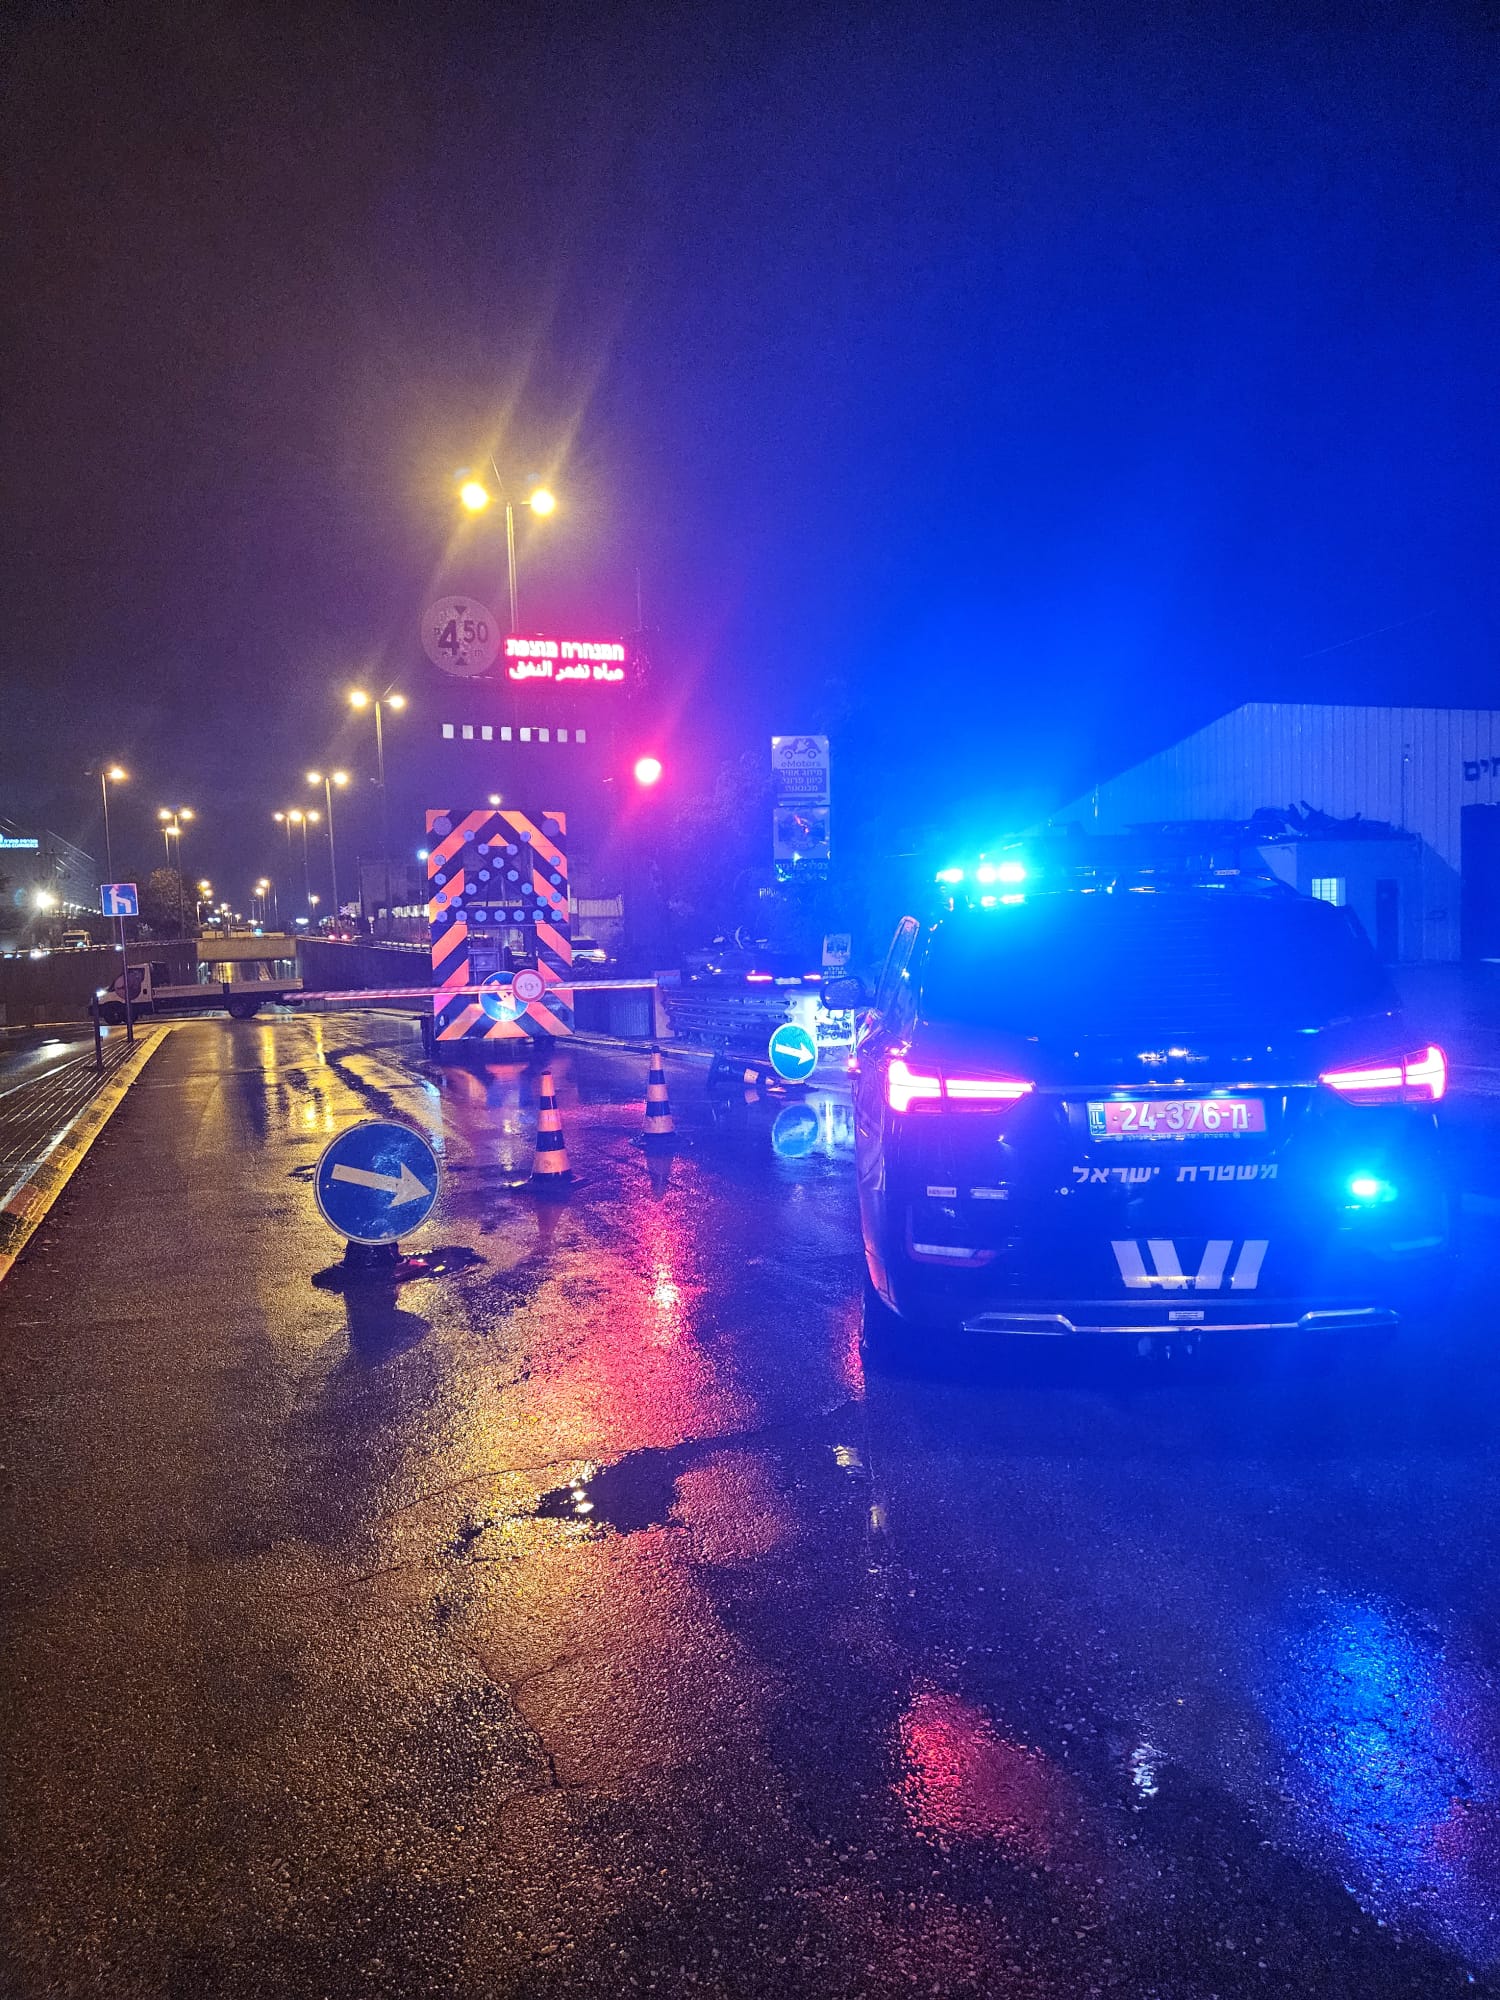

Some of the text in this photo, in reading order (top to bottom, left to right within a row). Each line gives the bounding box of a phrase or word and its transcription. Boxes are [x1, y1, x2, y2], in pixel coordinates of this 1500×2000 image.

[506, 638, 625, 661] המנהרה מוצפת
[509, 659, 624, 682] مياه تغمر النفق
[781, 760, 821, 768] eMotors
[1091, 1111, 1103, 1125] IL
[1072, 1164, 1279, 1183] משטרת ישראל
